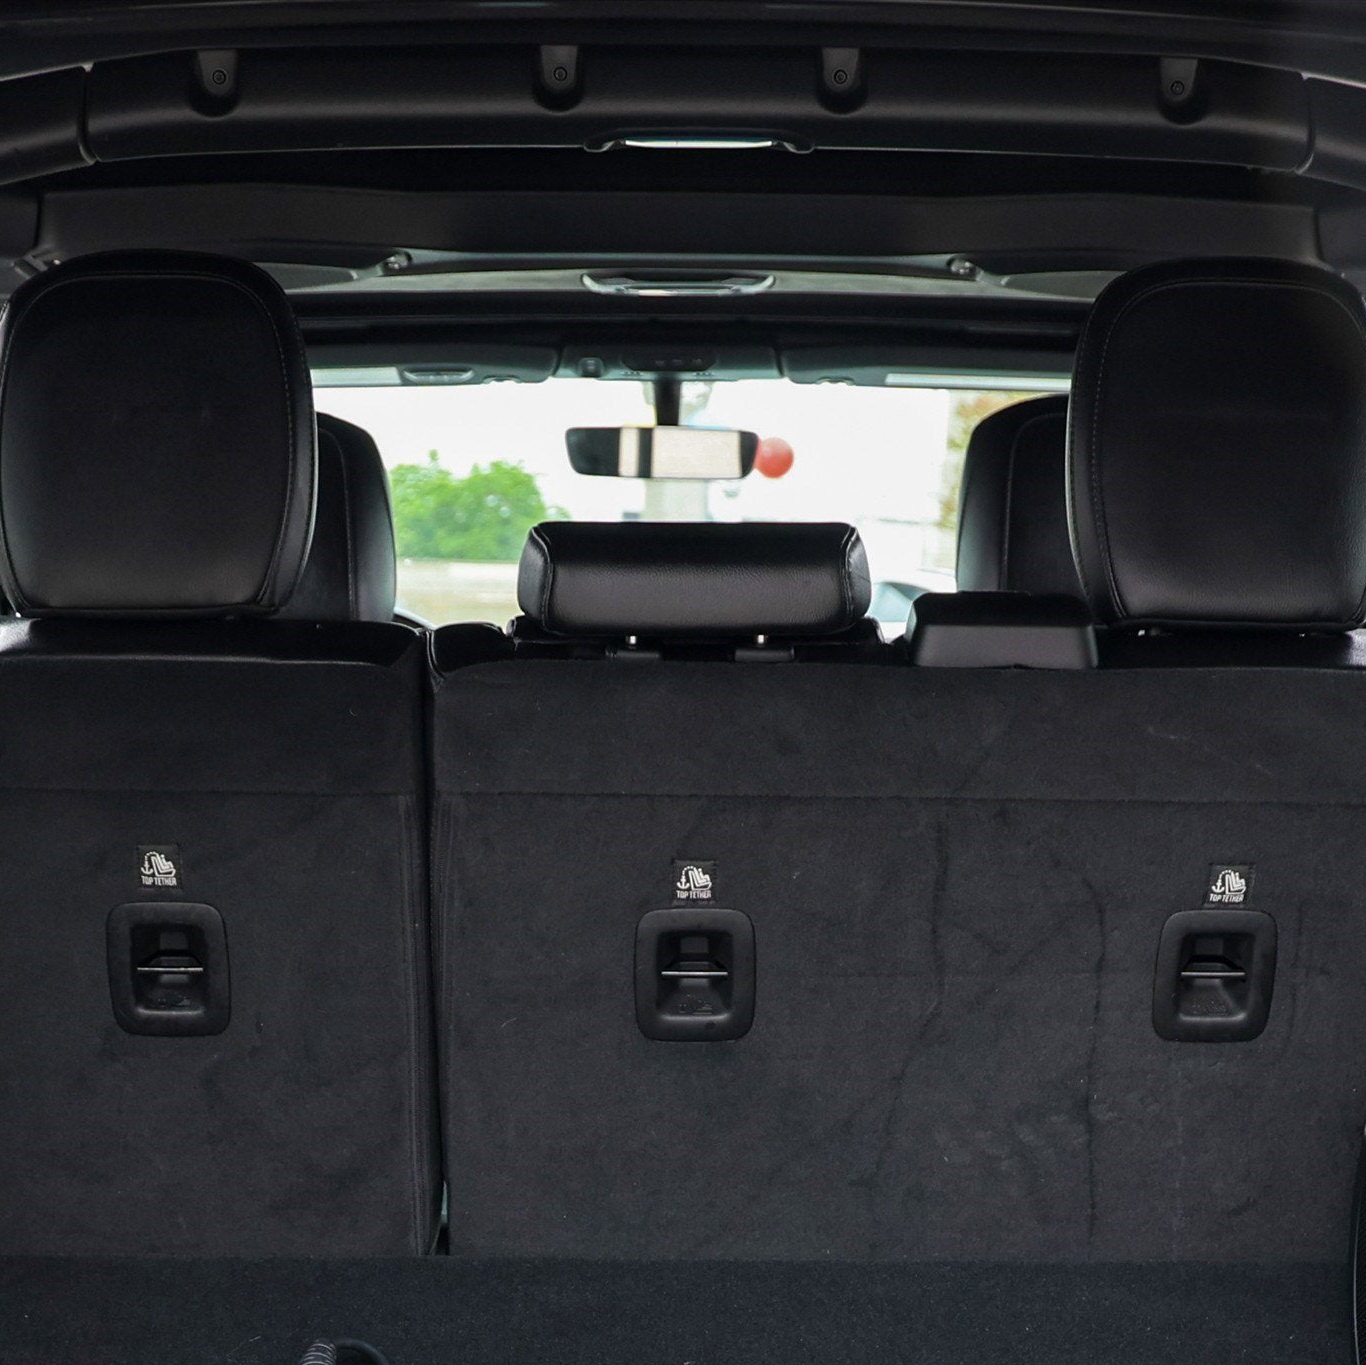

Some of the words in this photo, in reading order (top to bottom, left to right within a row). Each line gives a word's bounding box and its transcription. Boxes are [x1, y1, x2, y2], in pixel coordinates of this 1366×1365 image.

[141, 875, 154, 885] TOP
[154, 876, 177, 886] TETHER
[676, 890, 689, 899] TOP
[689, 890, 712, 899] TETHER
[1209, 893, 1222, 902] TOP
[1222, 894, 1244, 903] TETHER
